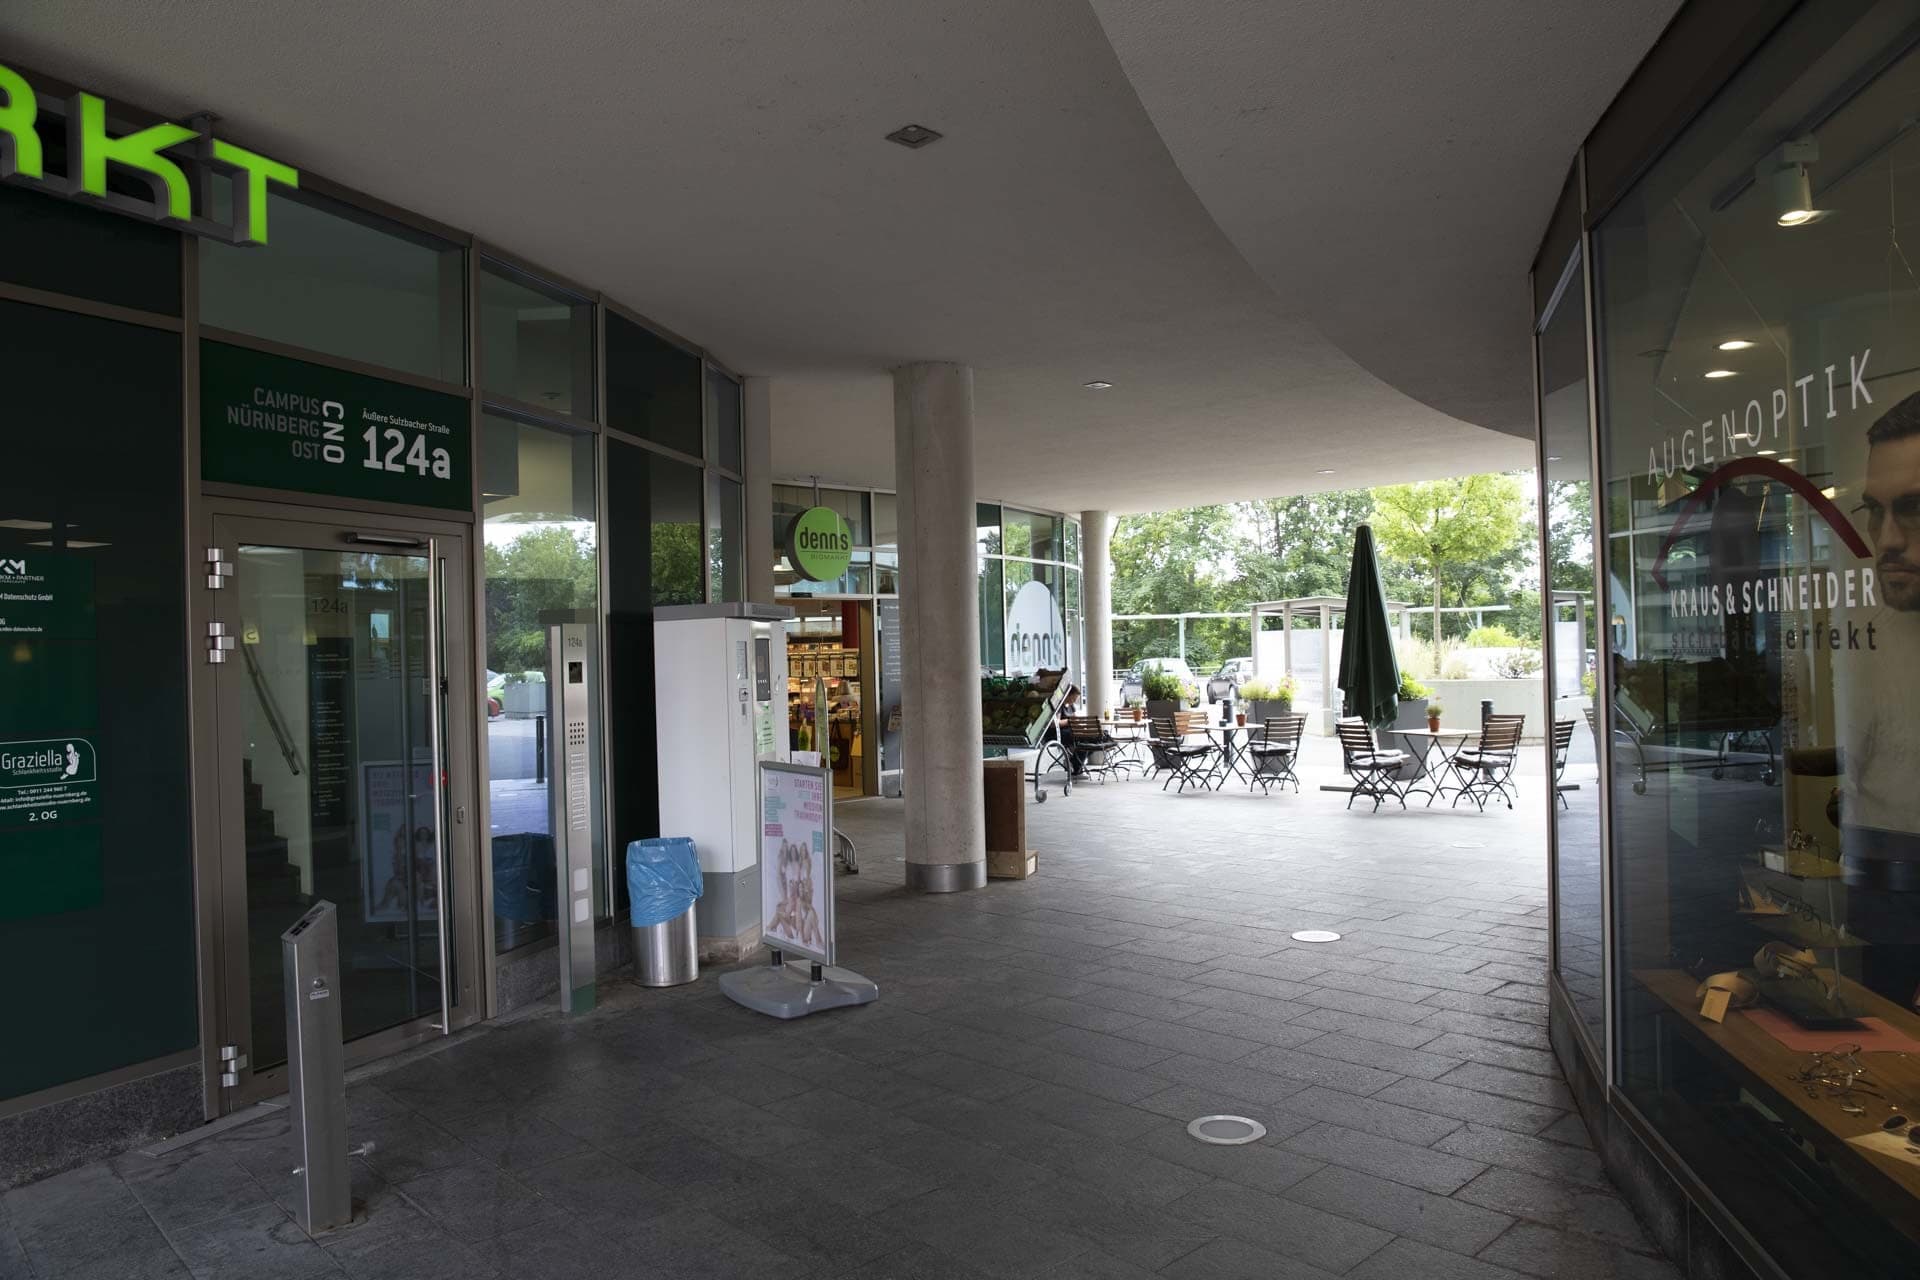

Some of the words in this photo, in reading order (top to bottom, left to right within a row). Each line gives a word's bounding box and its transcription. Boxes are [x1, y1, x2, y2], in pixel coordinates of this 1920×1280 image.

[253, 387, 320, 416] CAMPUS
[226, 402, 320, 438] NÜRNBERG
[362, 408, 389, 423] Äußere
[389, 414, 428, 430] Sulzbacher
[428, 421, 450, 435] Straße
[1647, 348, 1873, 486] AUGENOPTIK
[322, 400, 345, 464] CNO
[291, 440, 320, 461] OST
[362, 425, 451, 480] 124a
[312, 598, 348, 614] 124a
[1671, 584, 1720, 618] KRAUS
[1726, 584, 1736, 616] &
[1742, 567, 1877, 614] SCHNEIDER
[1, 749, 62, 769] Graziella
[28, 812, 38, 821] 2.
[41, 810, 57, 820] OG
